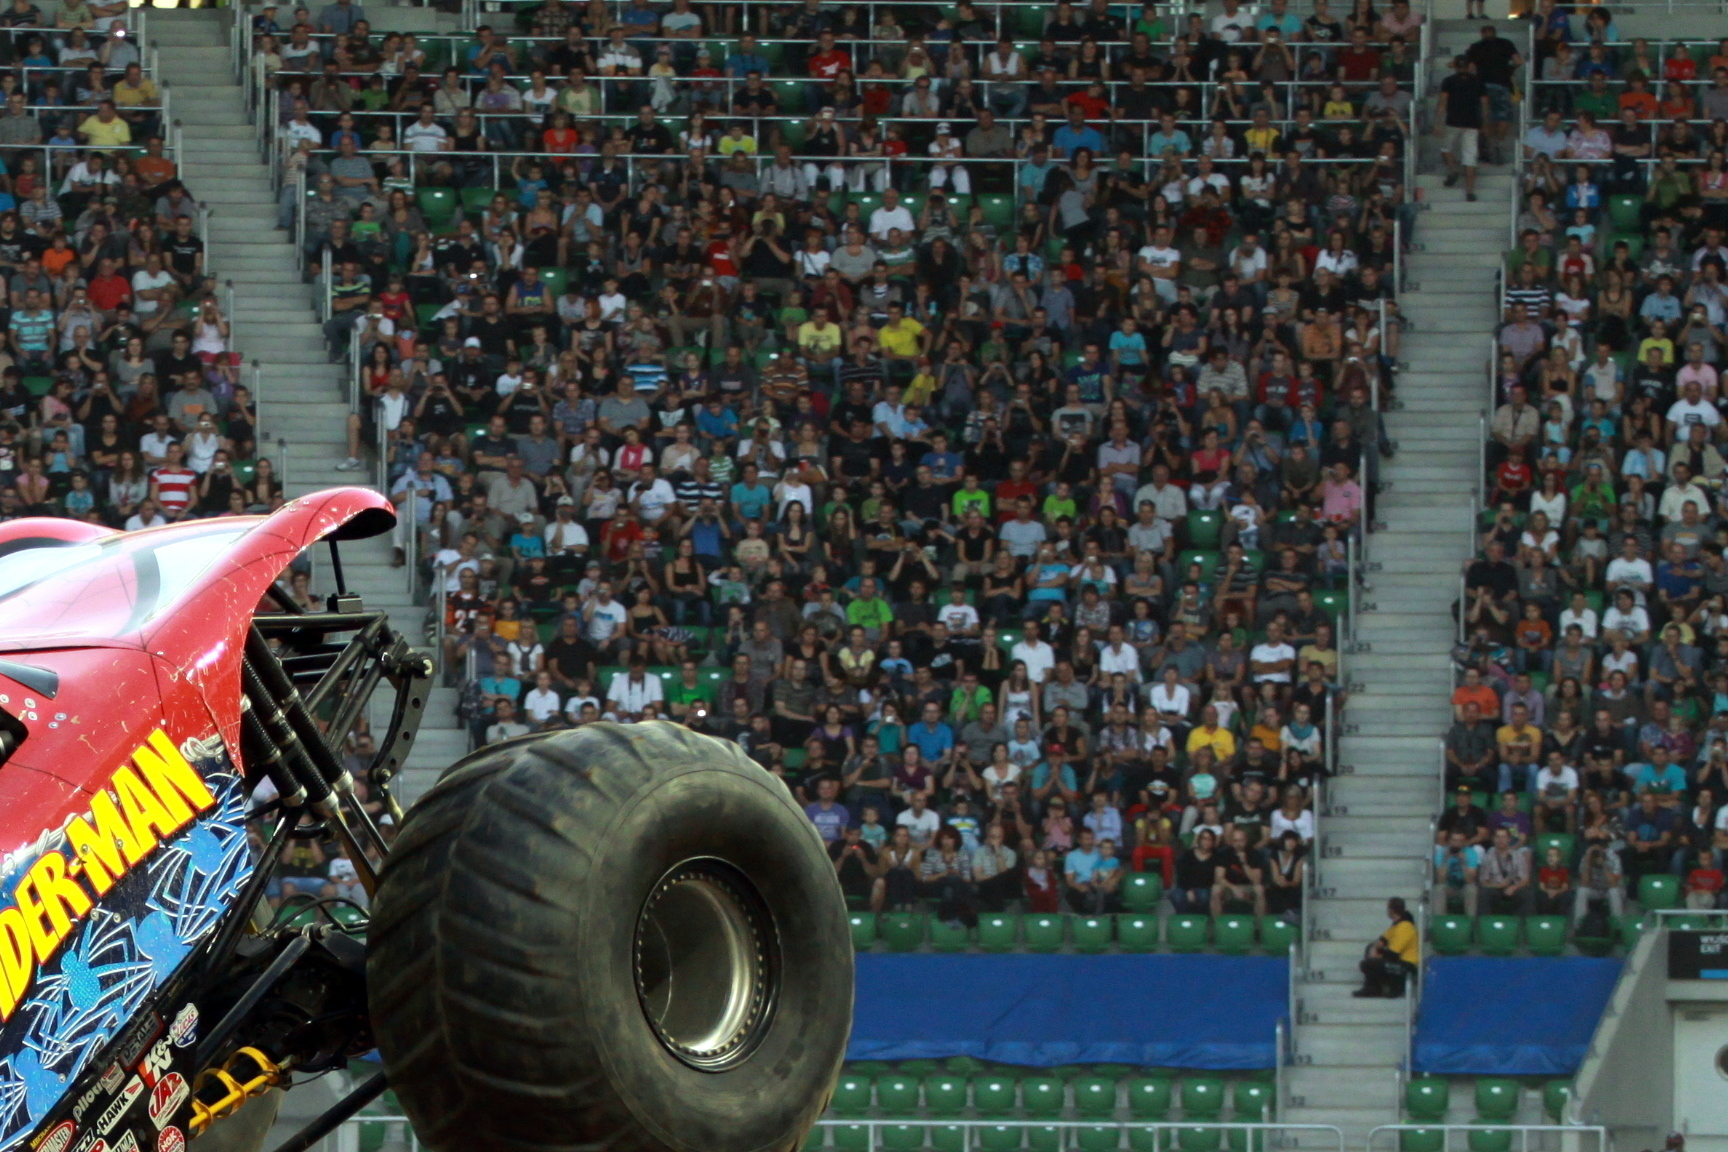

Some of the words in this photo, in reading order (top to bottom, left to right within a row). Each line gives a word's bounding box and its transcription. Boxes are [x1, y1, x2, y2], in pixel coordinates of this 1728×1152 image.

[1362, 602, 1377, 611] 24
[98, 1091, 130, 1131] HAWK
[160, 1130, 177, 1152] NGK
